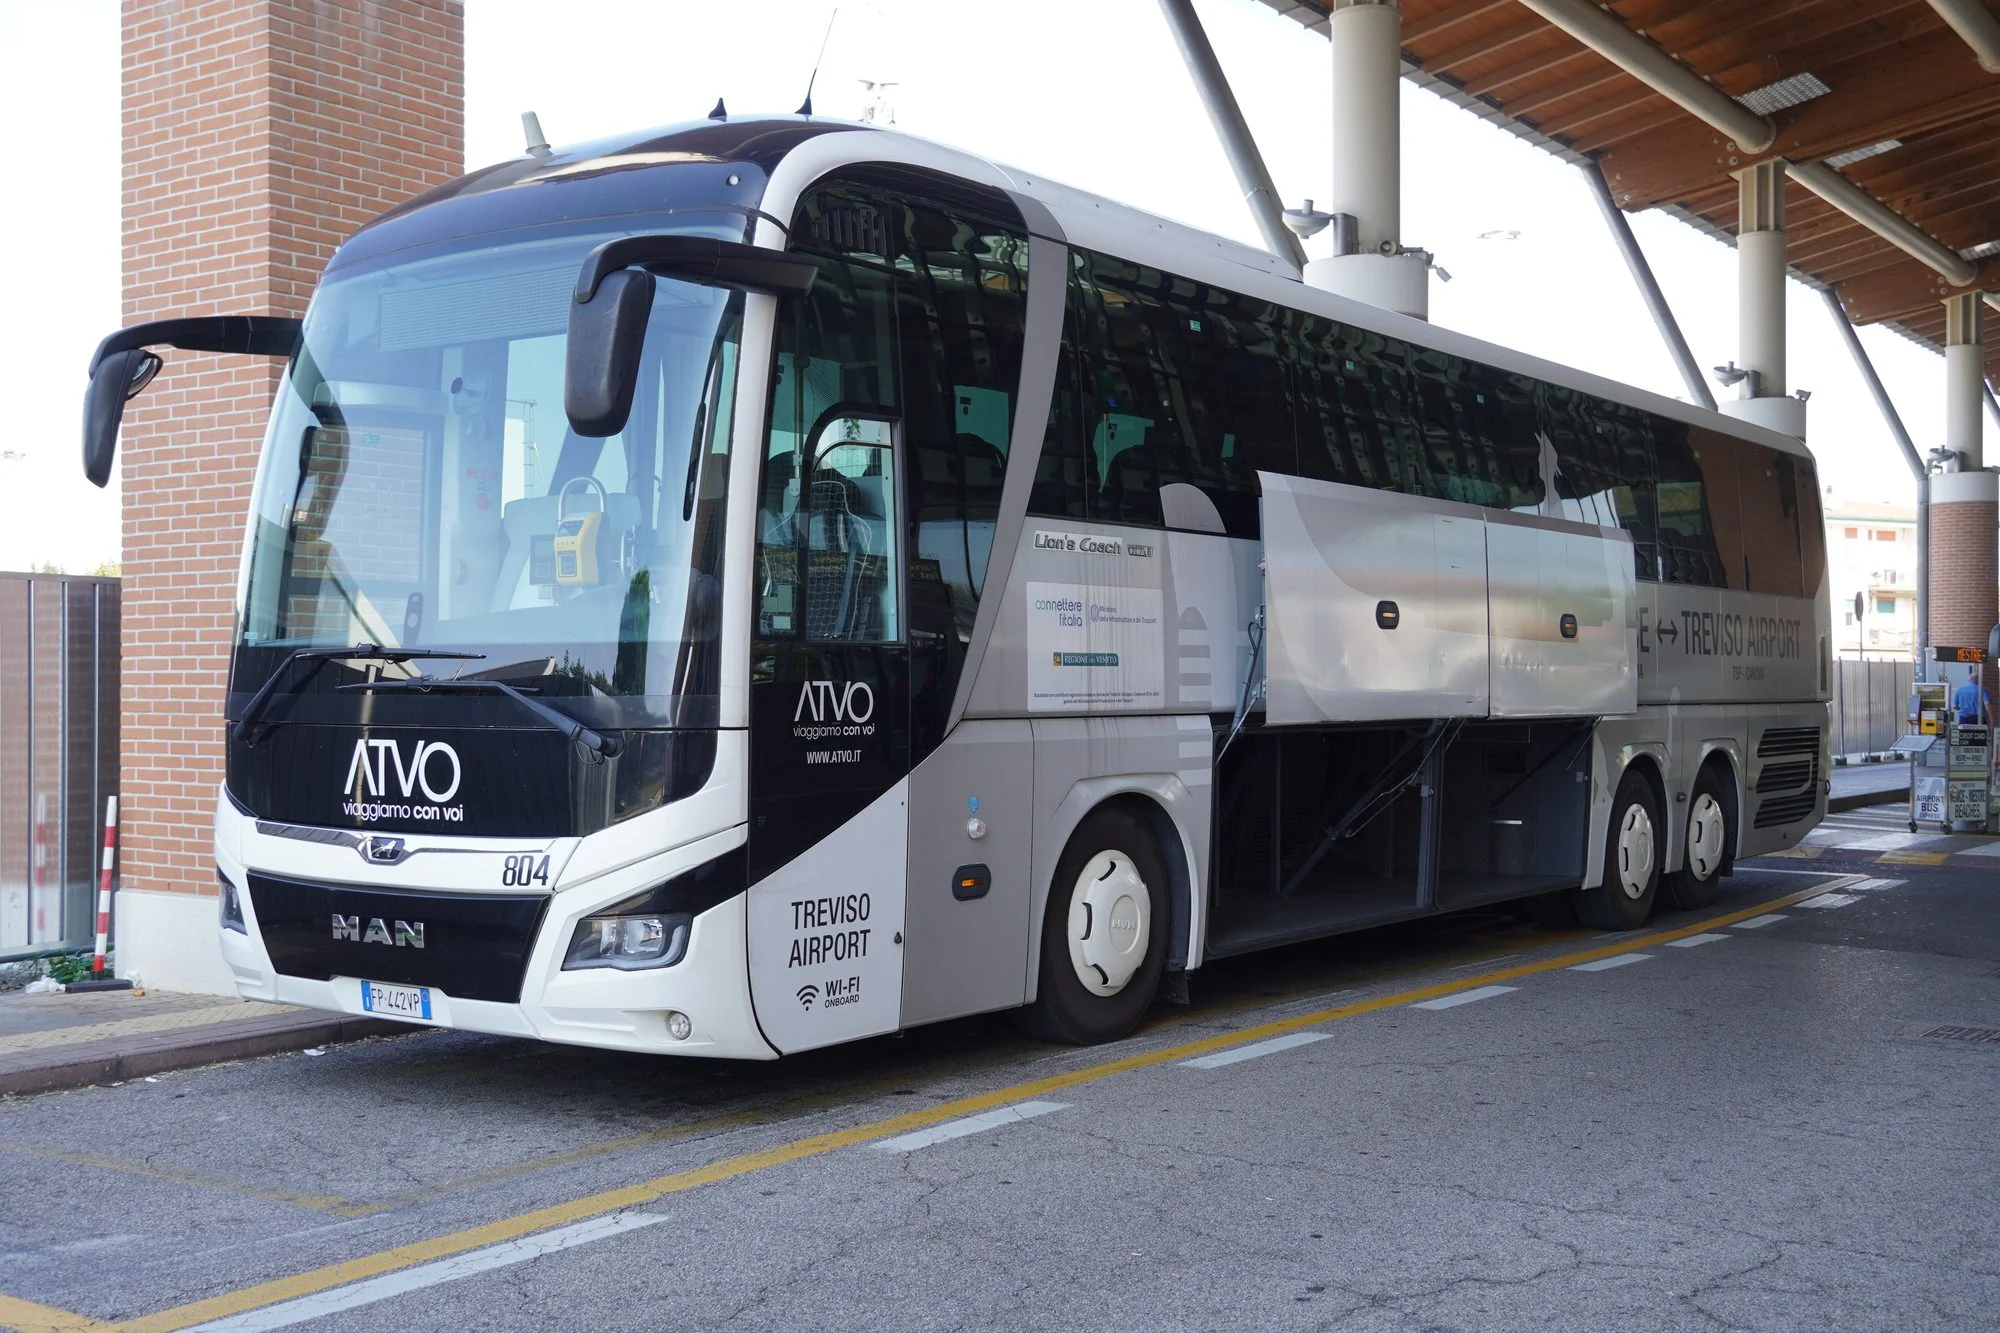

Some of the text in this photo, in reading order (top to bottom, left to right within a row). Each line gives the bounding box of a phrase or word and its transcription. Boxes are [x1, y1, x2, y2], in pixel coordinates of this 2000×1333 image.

[1034, 533, 1121, 554] Lion's Coach
[1035, 599, 1082, 612] connettere
[1636, 607, 1801, 659] E TREVISO AIRPORT
[794, 680, 874, 723] ATVO
[793, 723, 875, 740] viaggiamo con voi
[806, 749, 862, 764] WWW.ATVO.IT
[343, 738, 461, 802] ATVO
[343, 799, 463, 821] viaggiamo con voi
[1921, 802, 1939, 812] BUS
[1954, 803, 1980, 818] BEACHES
[502, 855, 550, 886] 804
[791, 893, 870, 930] TREVISO
[332, 914, 425, 948] MAN
[788, 928, 871, 968] AIRPORT
[826, 976, 860, 997] WI-FI
[824, 994, 860, 1008] ONBOARD
